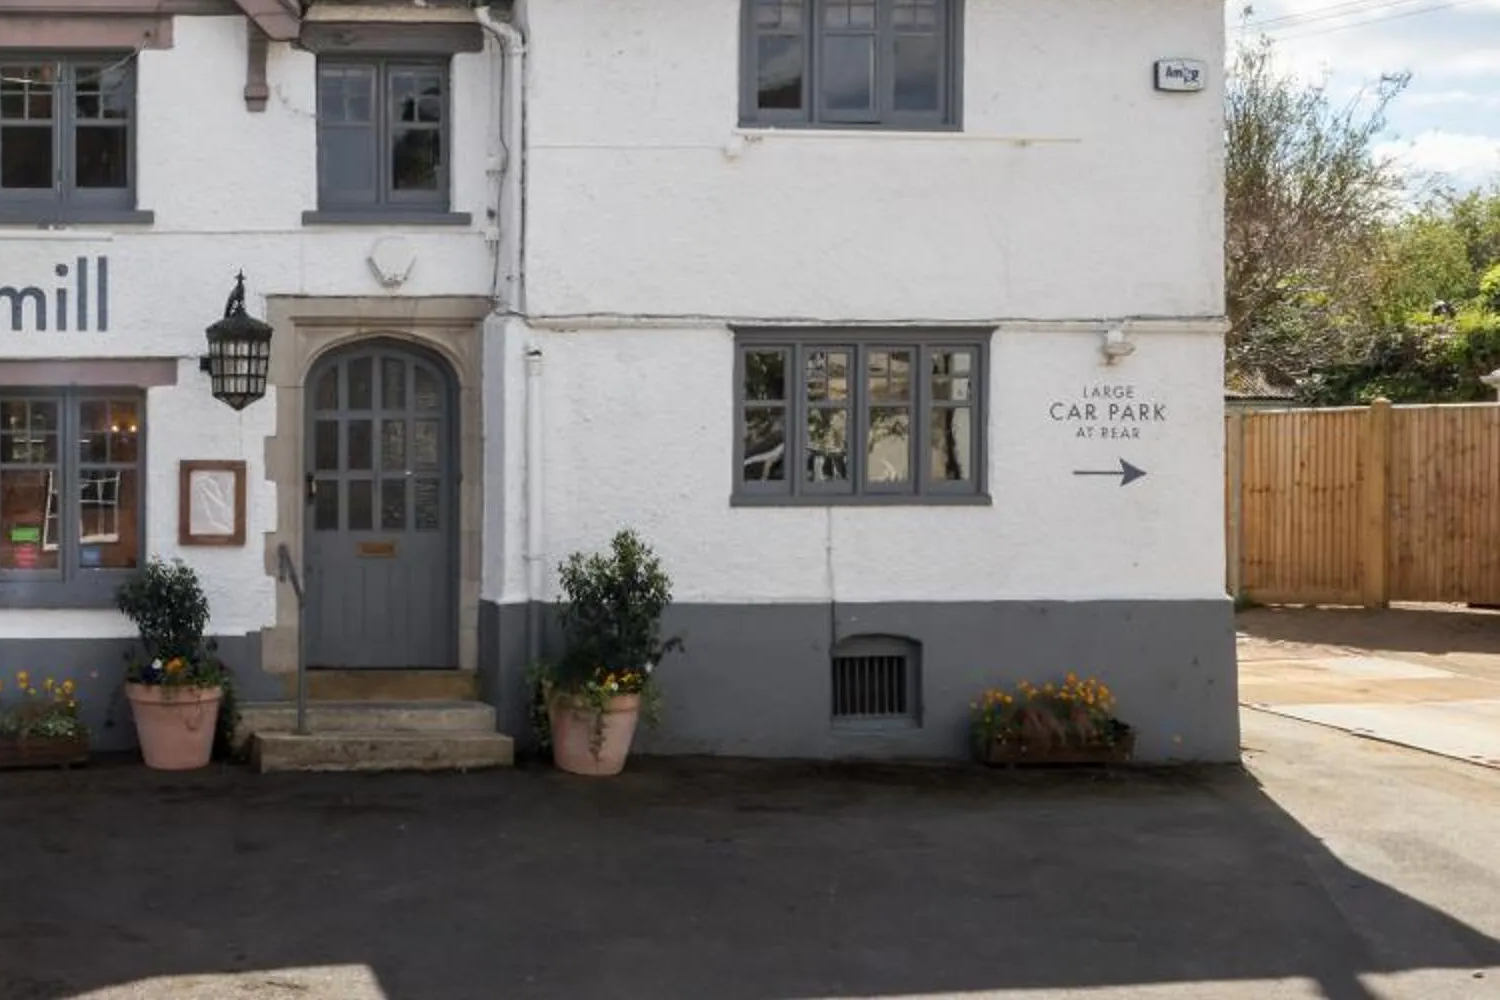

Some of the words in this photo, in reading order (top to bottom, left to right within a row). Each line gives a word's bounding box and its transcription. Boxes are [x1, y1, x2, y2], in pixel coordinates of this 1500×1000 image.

[1083, 385, 1135, 399] LARGE
[1049, 402, 1098, 421] CAR
[1109, 403, 1167, 421] PARK
[1075, 427, 1094, 439] AT
[1101, 427, 1141, 440] REAR
